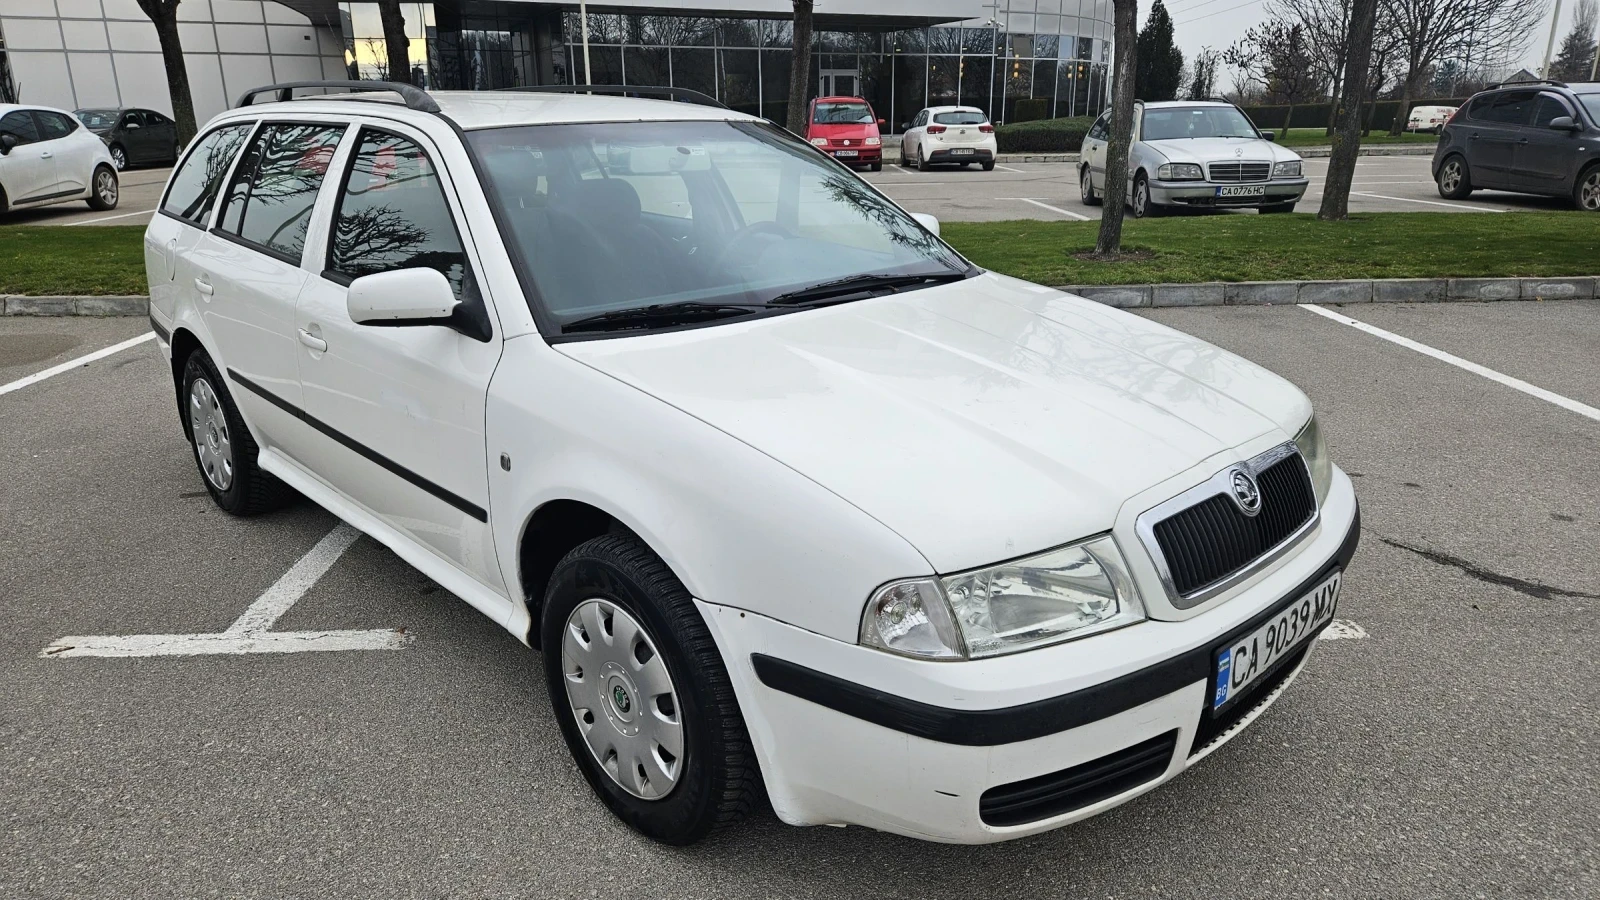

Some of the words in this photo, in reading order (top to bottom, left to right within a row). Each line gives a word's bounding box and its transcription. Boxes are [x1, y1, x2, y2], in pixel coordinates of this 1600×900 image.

[1221, 187, 1232, 195] CA
[1233, 187, 1252, 195] 0776
[1253, 186, 1264, 194] HC
[1232, 637, 1258, 689] CA
[1264, 600, 1310, 665] 9039
[1309, 578, 1338, 629] MX
[1216, 684, 1227, 700] BG
